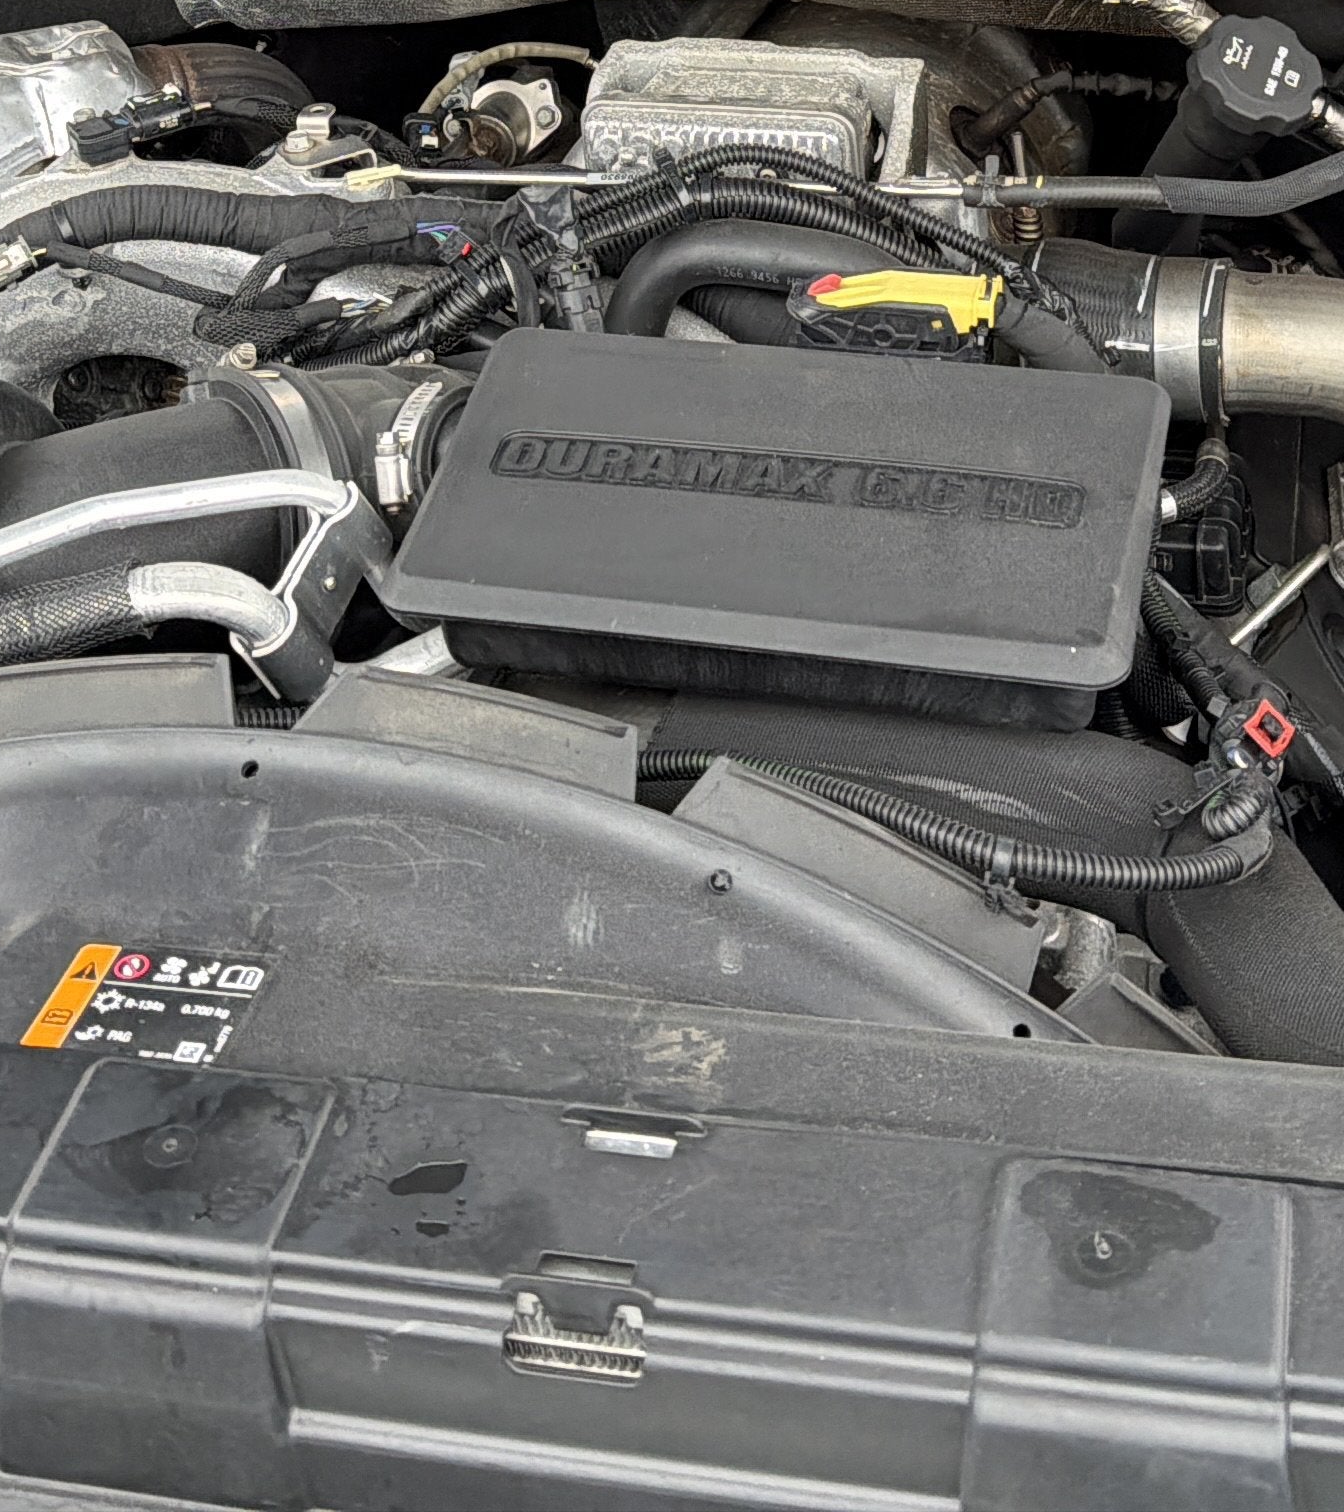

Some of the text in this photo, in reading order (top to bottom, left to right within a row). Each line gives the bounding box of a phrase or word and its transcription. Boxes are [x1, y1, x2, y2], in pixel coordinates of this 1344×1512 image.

[496, 434, 1084, 528] DURAMAX 6.6 HD
[153, 973, 181, 984] AUTO
[124, 998, 231, 1020] R-134a 0.700 kg
[106, 1030, 133, 1043] PAG
